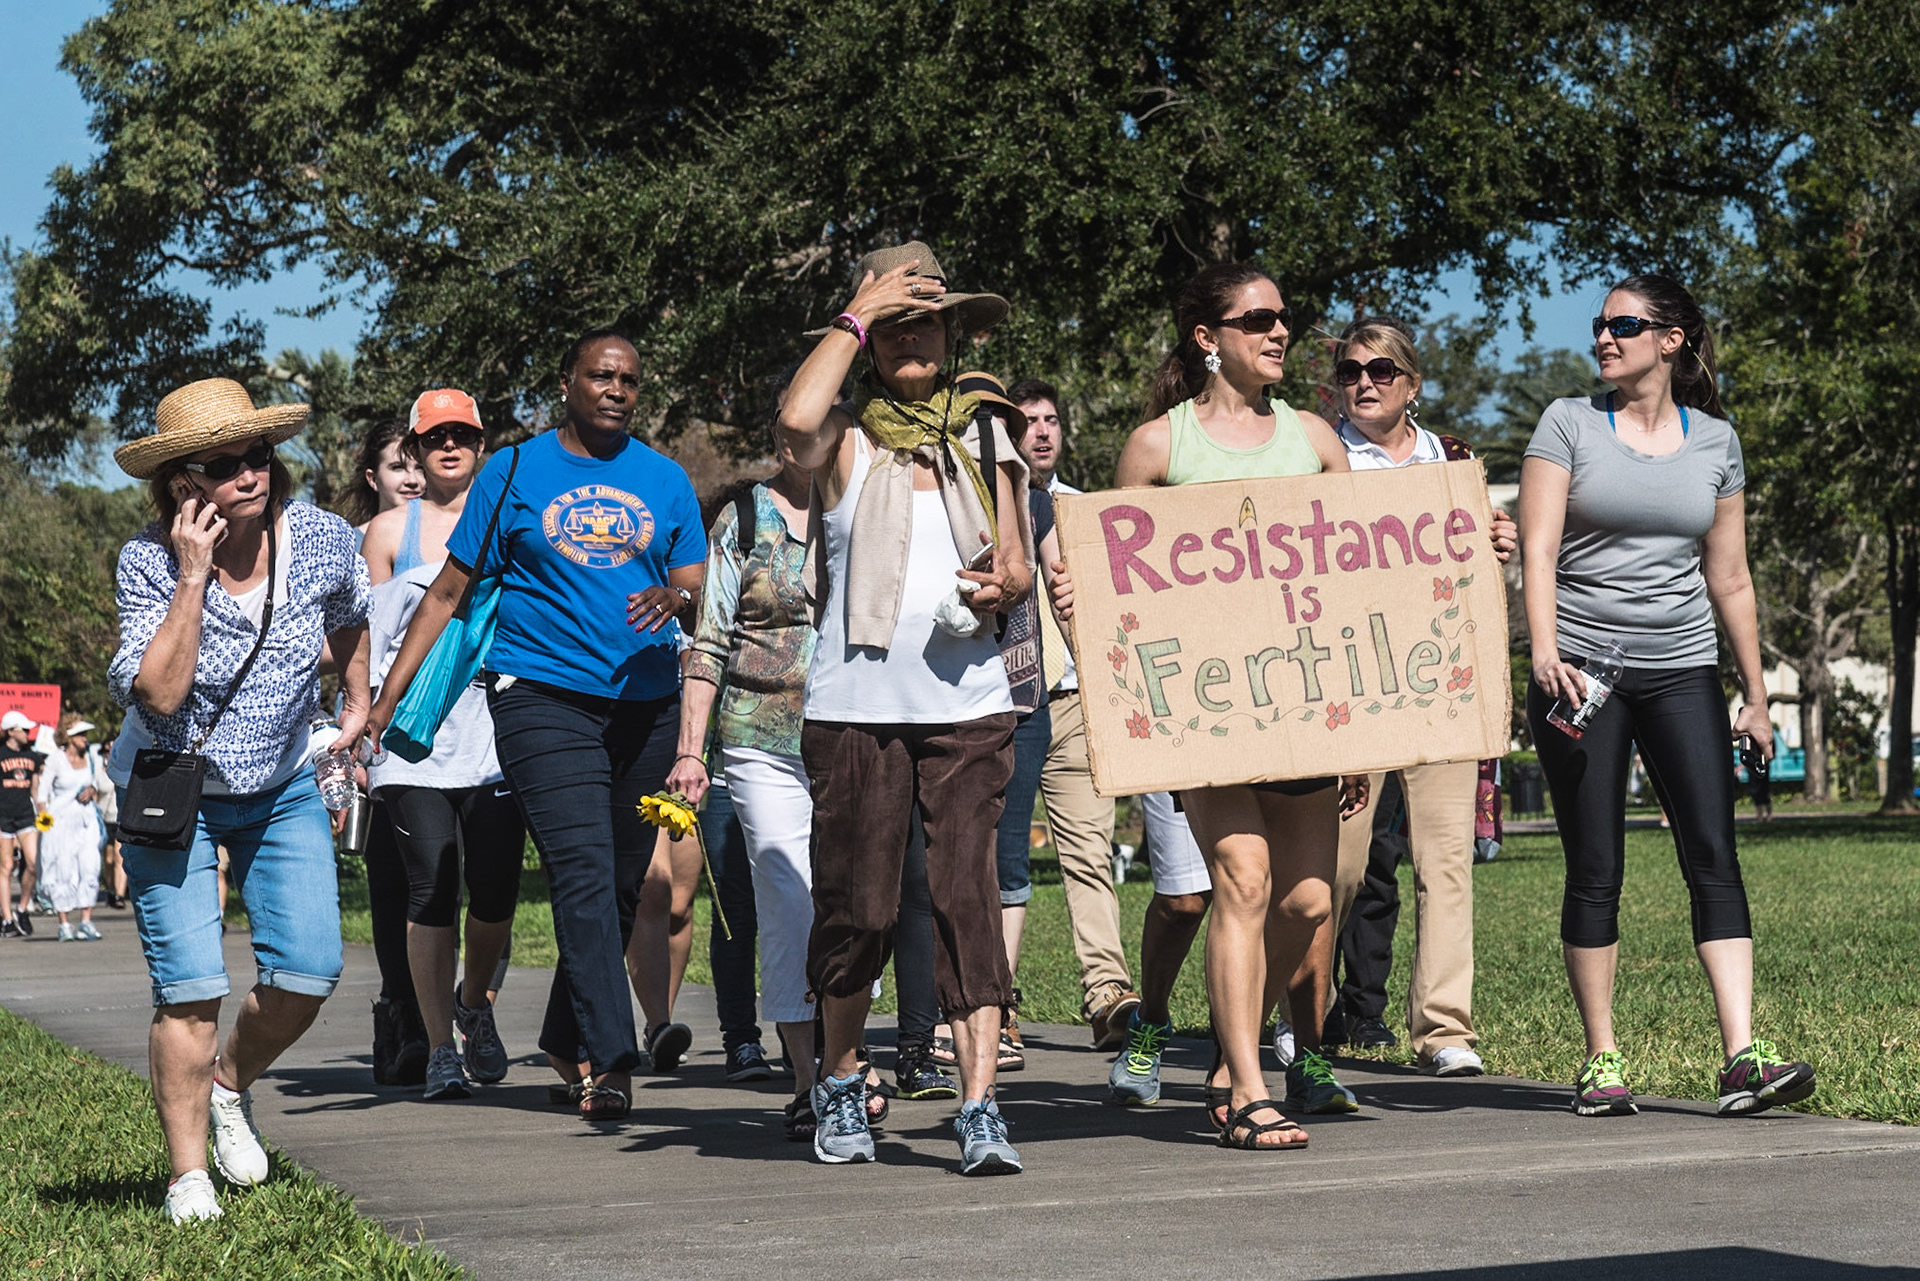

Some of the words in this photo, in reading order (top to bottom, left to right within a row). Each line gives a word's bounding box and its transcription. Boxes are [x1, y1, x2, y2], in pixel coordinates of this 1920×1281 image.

[576, 487, 591, 498] THE
[595, 486, 644, 509] ADVANCEMENT
[581, 515, 617, 526] NAACP
[1098, 496, 1478, 596] Resistance
[1280, 583, 1322, 624] is
[1134, 612, 1443, 718] Fertile
